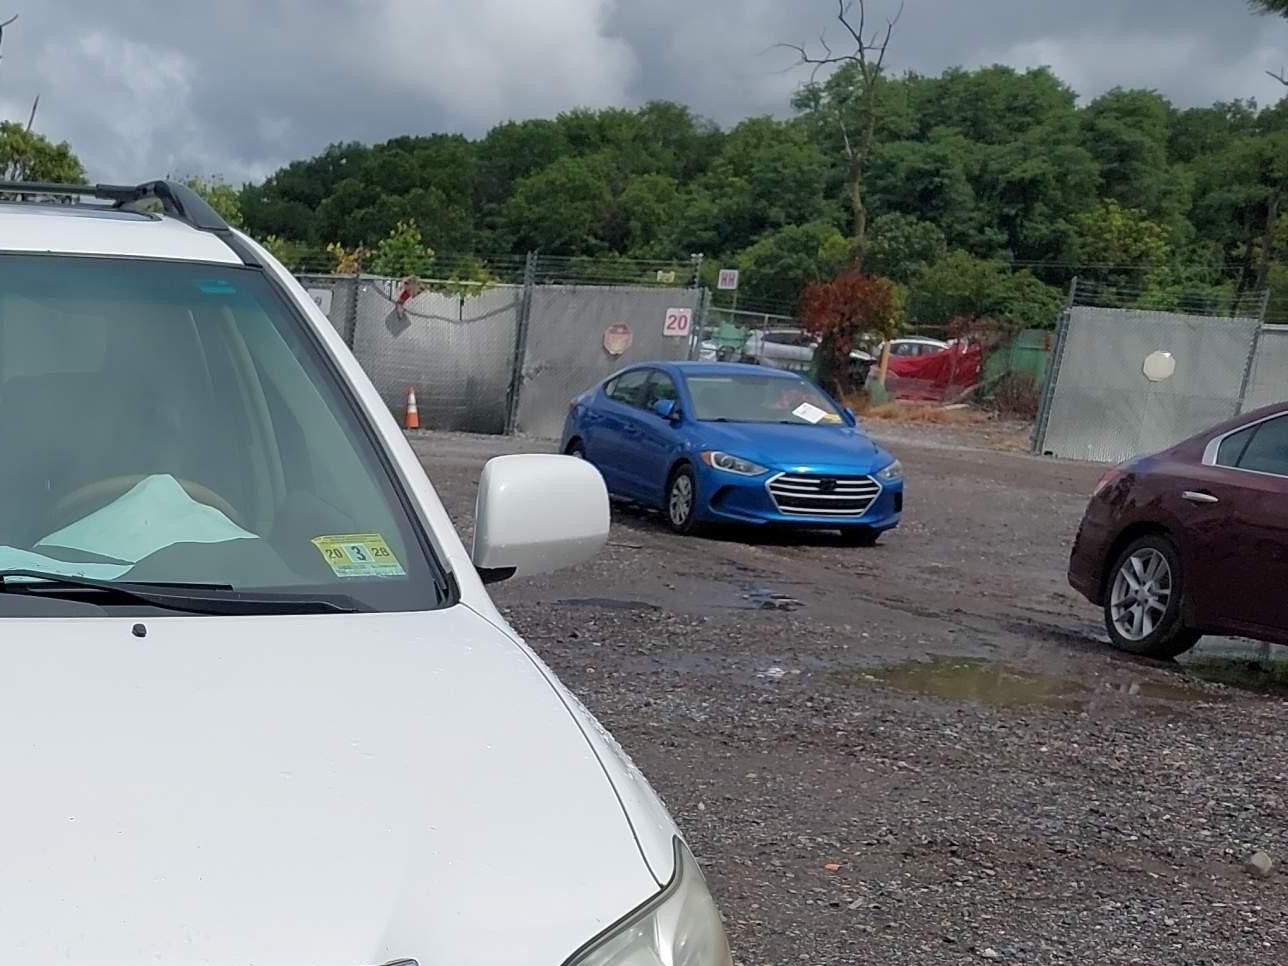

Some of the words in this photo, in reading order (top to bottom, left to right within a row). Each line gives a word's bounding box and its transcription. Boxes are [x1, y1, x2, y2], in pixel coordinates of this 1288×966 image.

[721, 272, 736, 287] HH
[666, 314, 688, 331] 20
[325, 548, 344, 559] 20
[351, 545, 367, 561] 3
